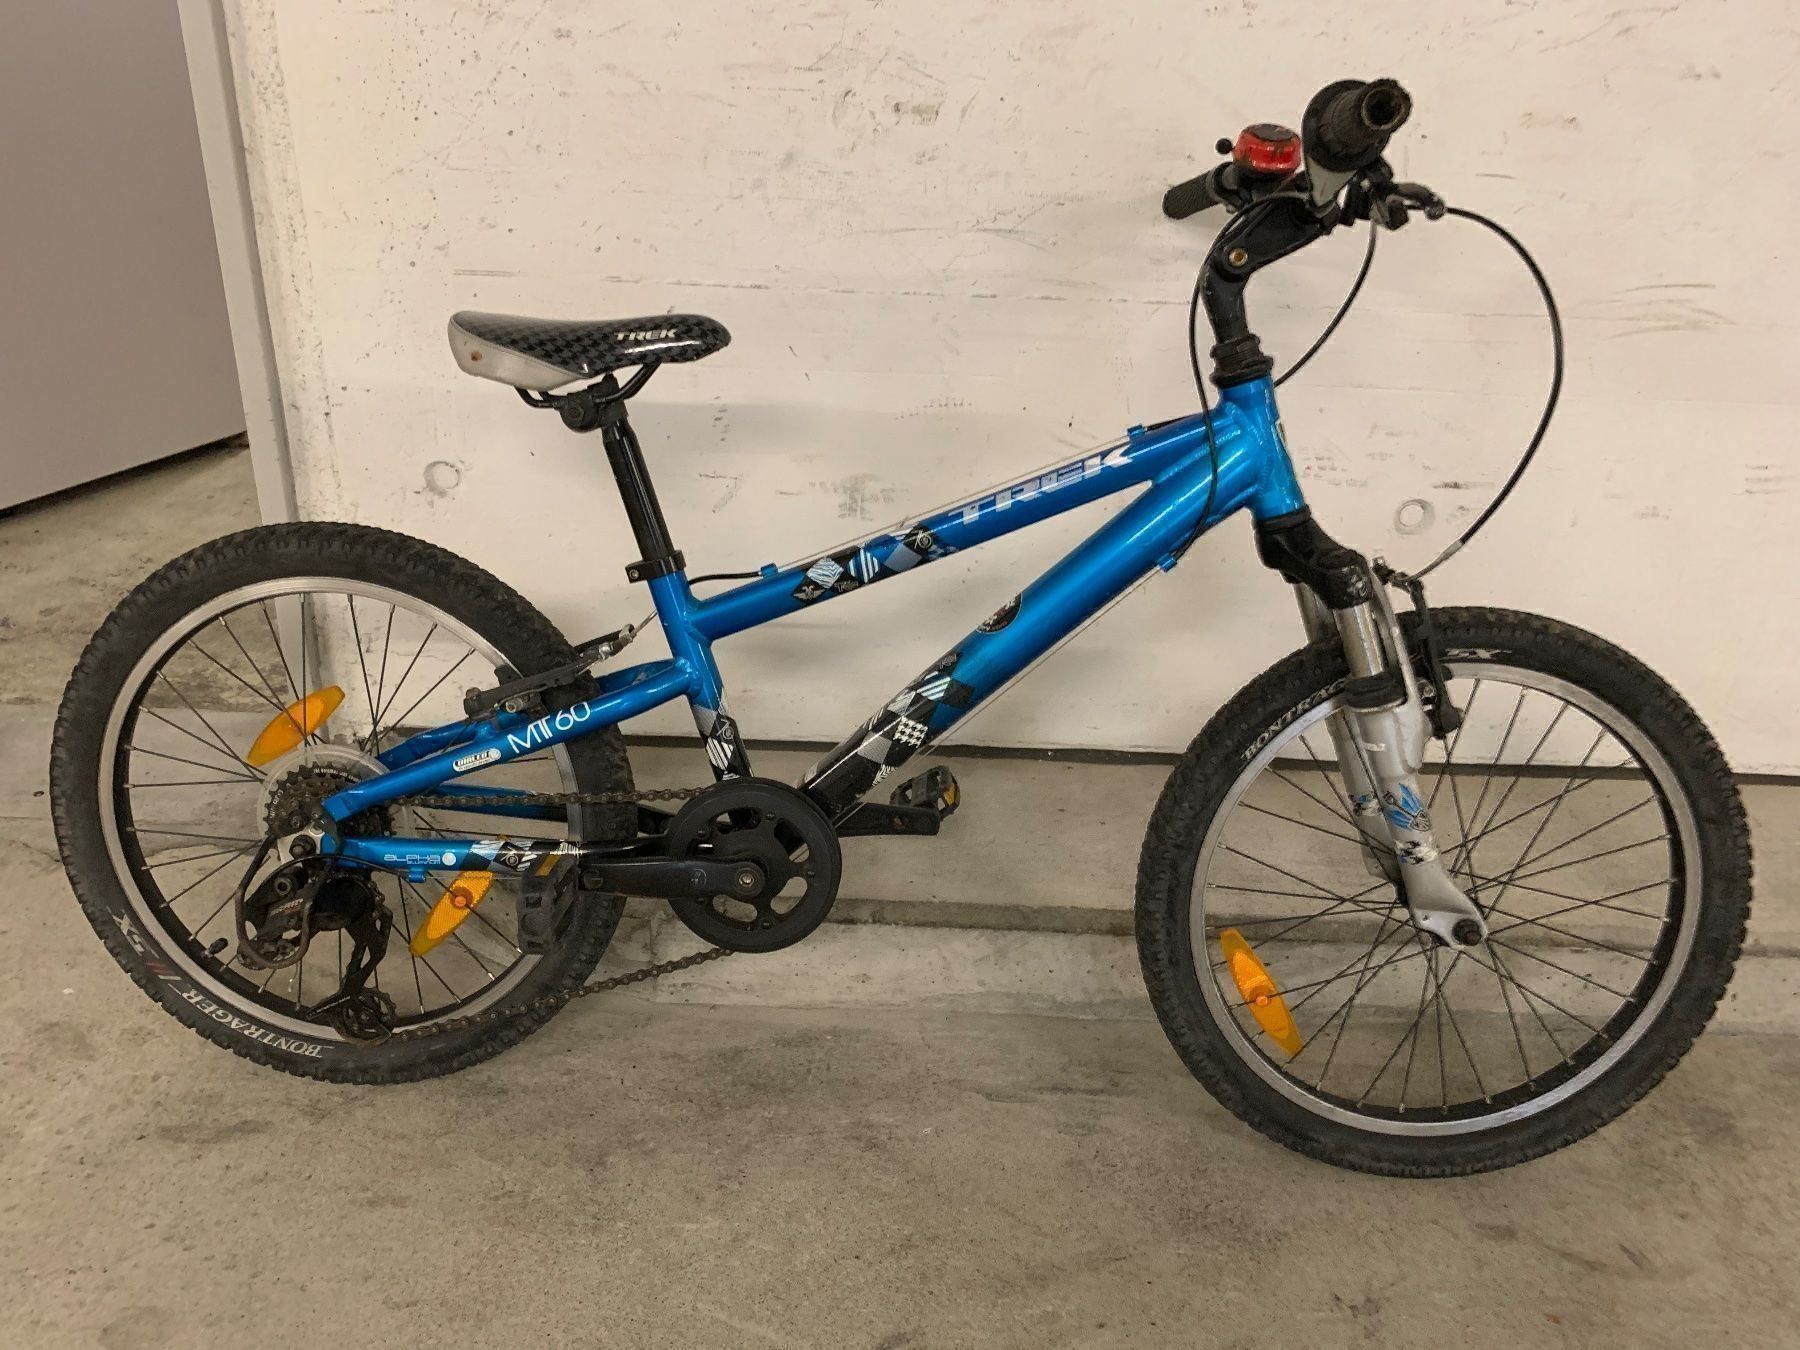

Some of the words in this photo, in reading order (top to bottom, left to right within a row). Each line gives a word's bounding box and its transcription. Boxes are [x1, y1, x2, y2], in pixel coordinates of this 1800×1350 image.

[614, 328, 677, 341] TREK
[948, 444, 1132, 525] TREK
[168, 984, 334, 1059] BONTRAGER
